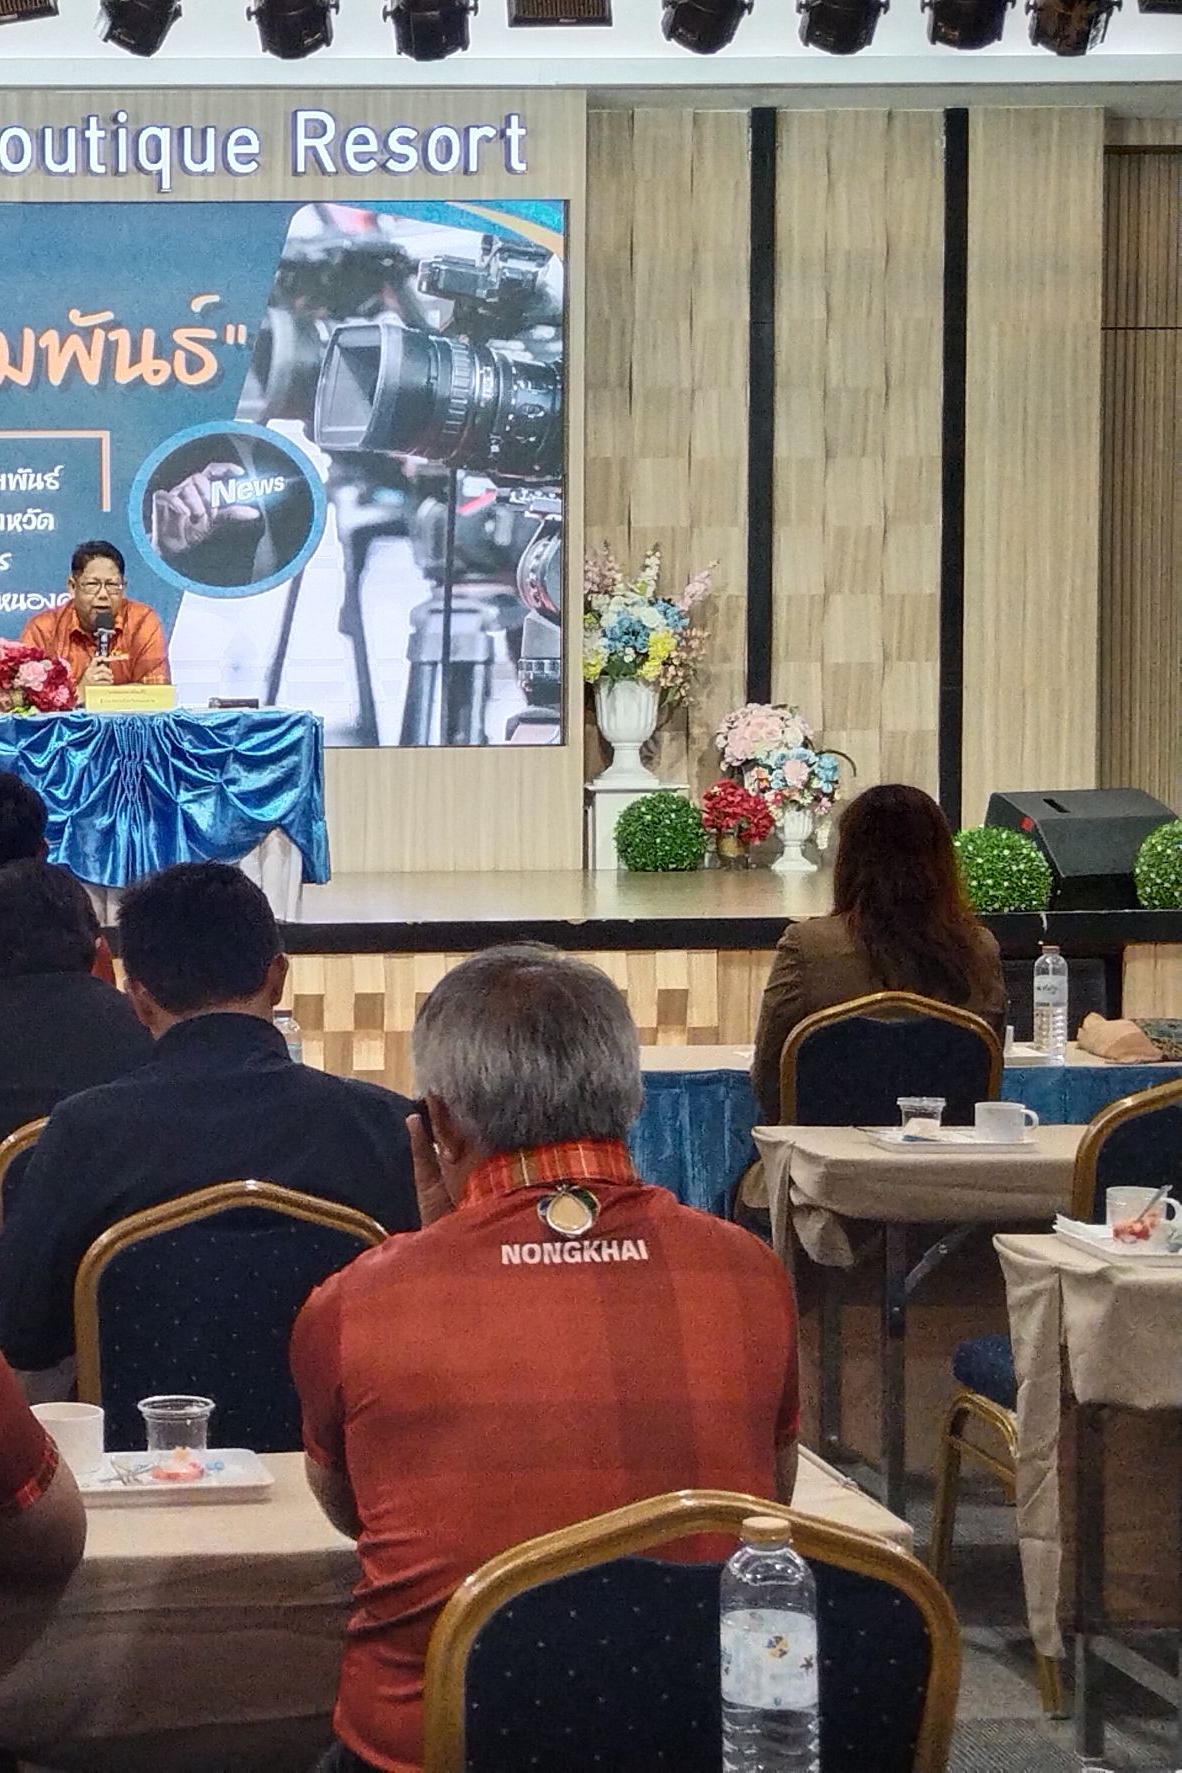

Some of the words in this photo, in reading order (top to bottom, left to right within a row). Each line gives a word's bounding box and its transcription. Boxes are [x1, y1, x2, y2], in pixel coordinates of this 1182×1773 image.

[292, 108, 528, 175] Resort
[211, 476, 285, 508] News
[501, 1239, 648, 1265] NONGKHAI
